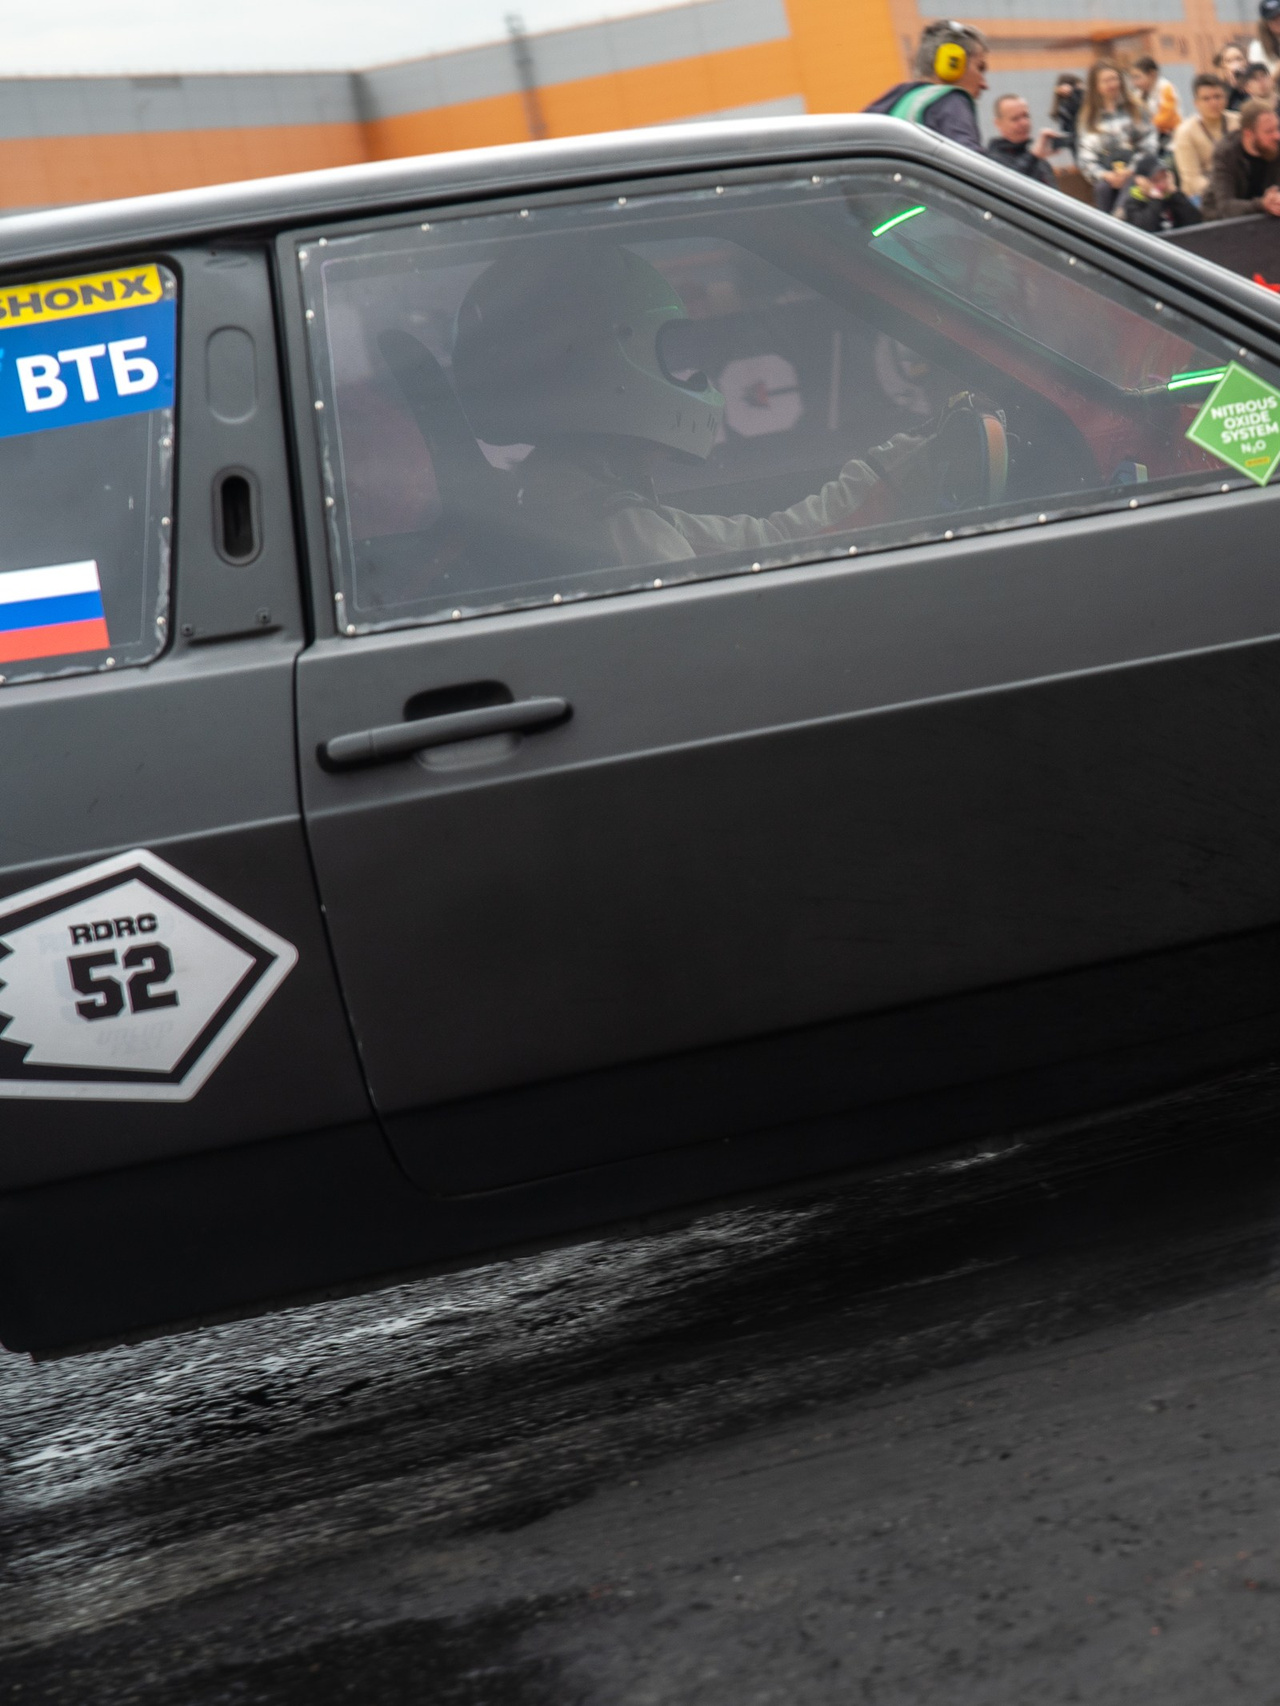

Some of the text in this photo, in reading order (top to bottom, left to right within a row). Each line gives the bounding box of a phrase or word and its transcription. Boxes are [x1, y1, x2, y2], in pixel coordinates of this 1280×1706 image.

[0, 274, 154, 320] HONX
[16, 336, 159, 413] ВТБ
[1210, 396, 1278, 420] NITROUS
[1223, 410, 1271, 430] OXIDE
[1221, 422, 1279, 444] SYSTEM
[68, 912, 158, 945] RDRC
[67, 941, 180, 1022] 52
